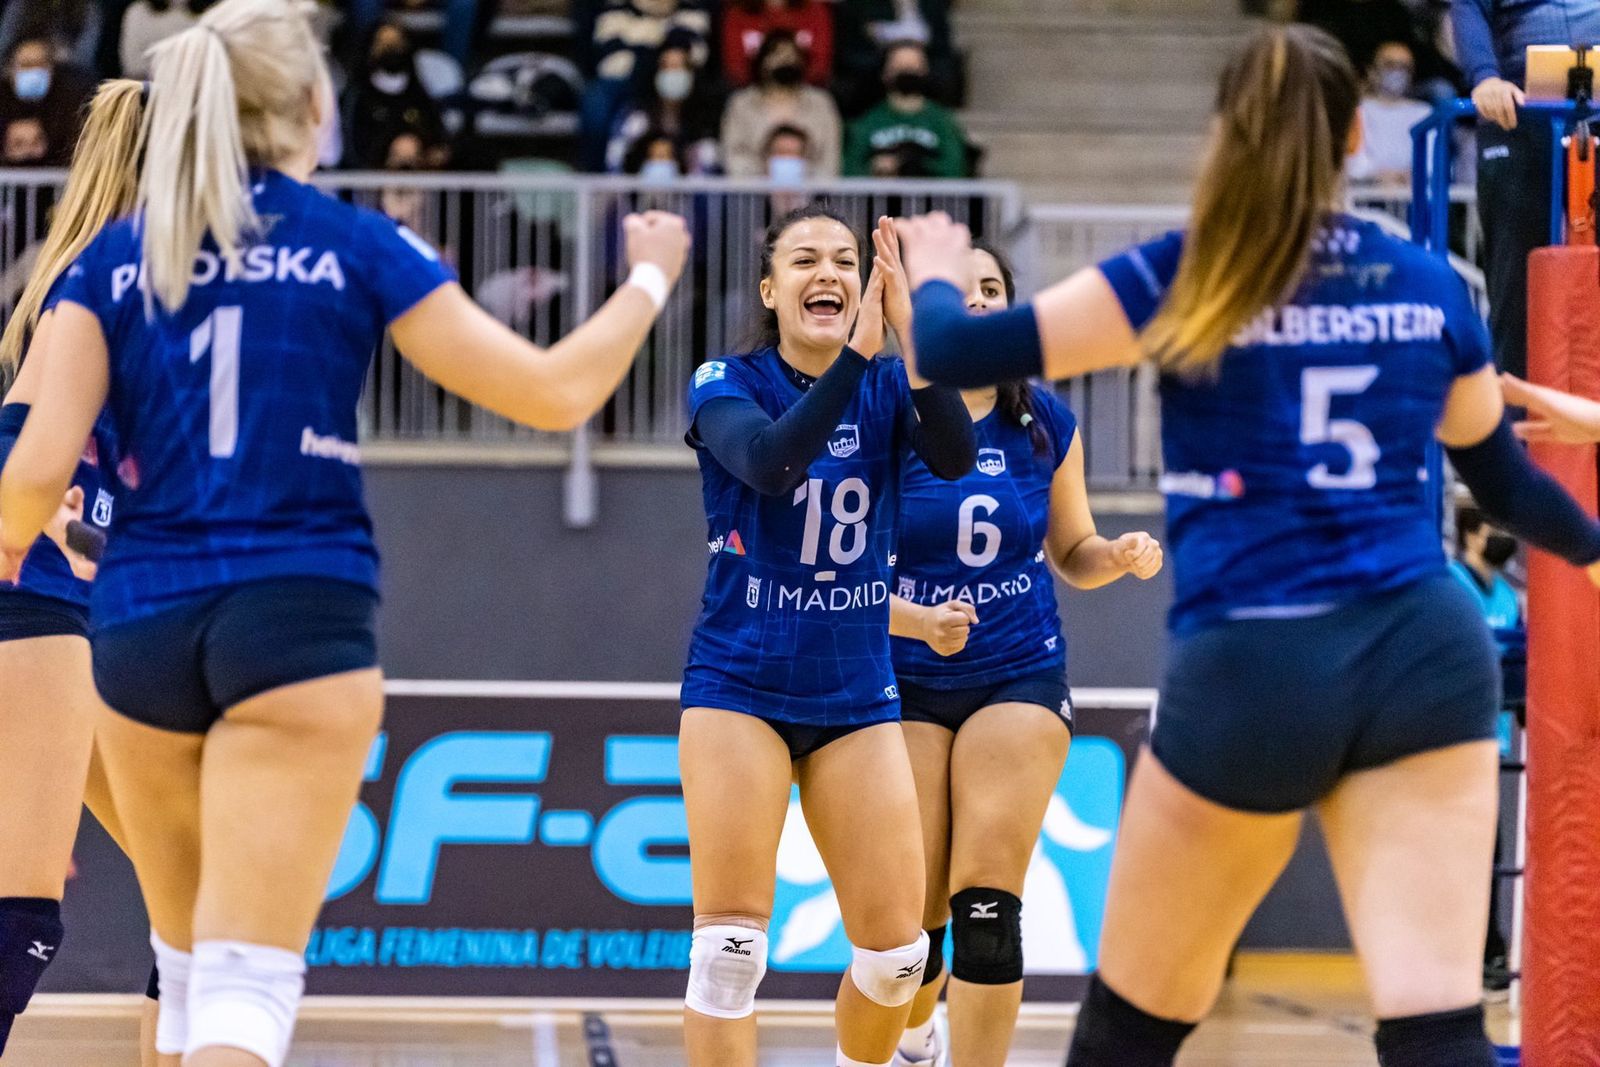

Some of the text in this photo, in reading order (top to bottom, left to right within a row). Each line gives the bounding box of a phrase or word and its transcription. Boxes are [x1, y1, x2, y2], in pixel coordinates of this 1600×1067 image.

[189, 305, 243, 458] 1
[1300, 364, 1382, 489] 5
[793, 477, 870, 566] 18
[957, 494, 1002, 567] 6
[778, 580, 887, 611] MADRID
[931, 573, 1031, 604] MADRID
[379, 927, 539, 967] FEMENINA
[541, 928, 583, 969] DE
